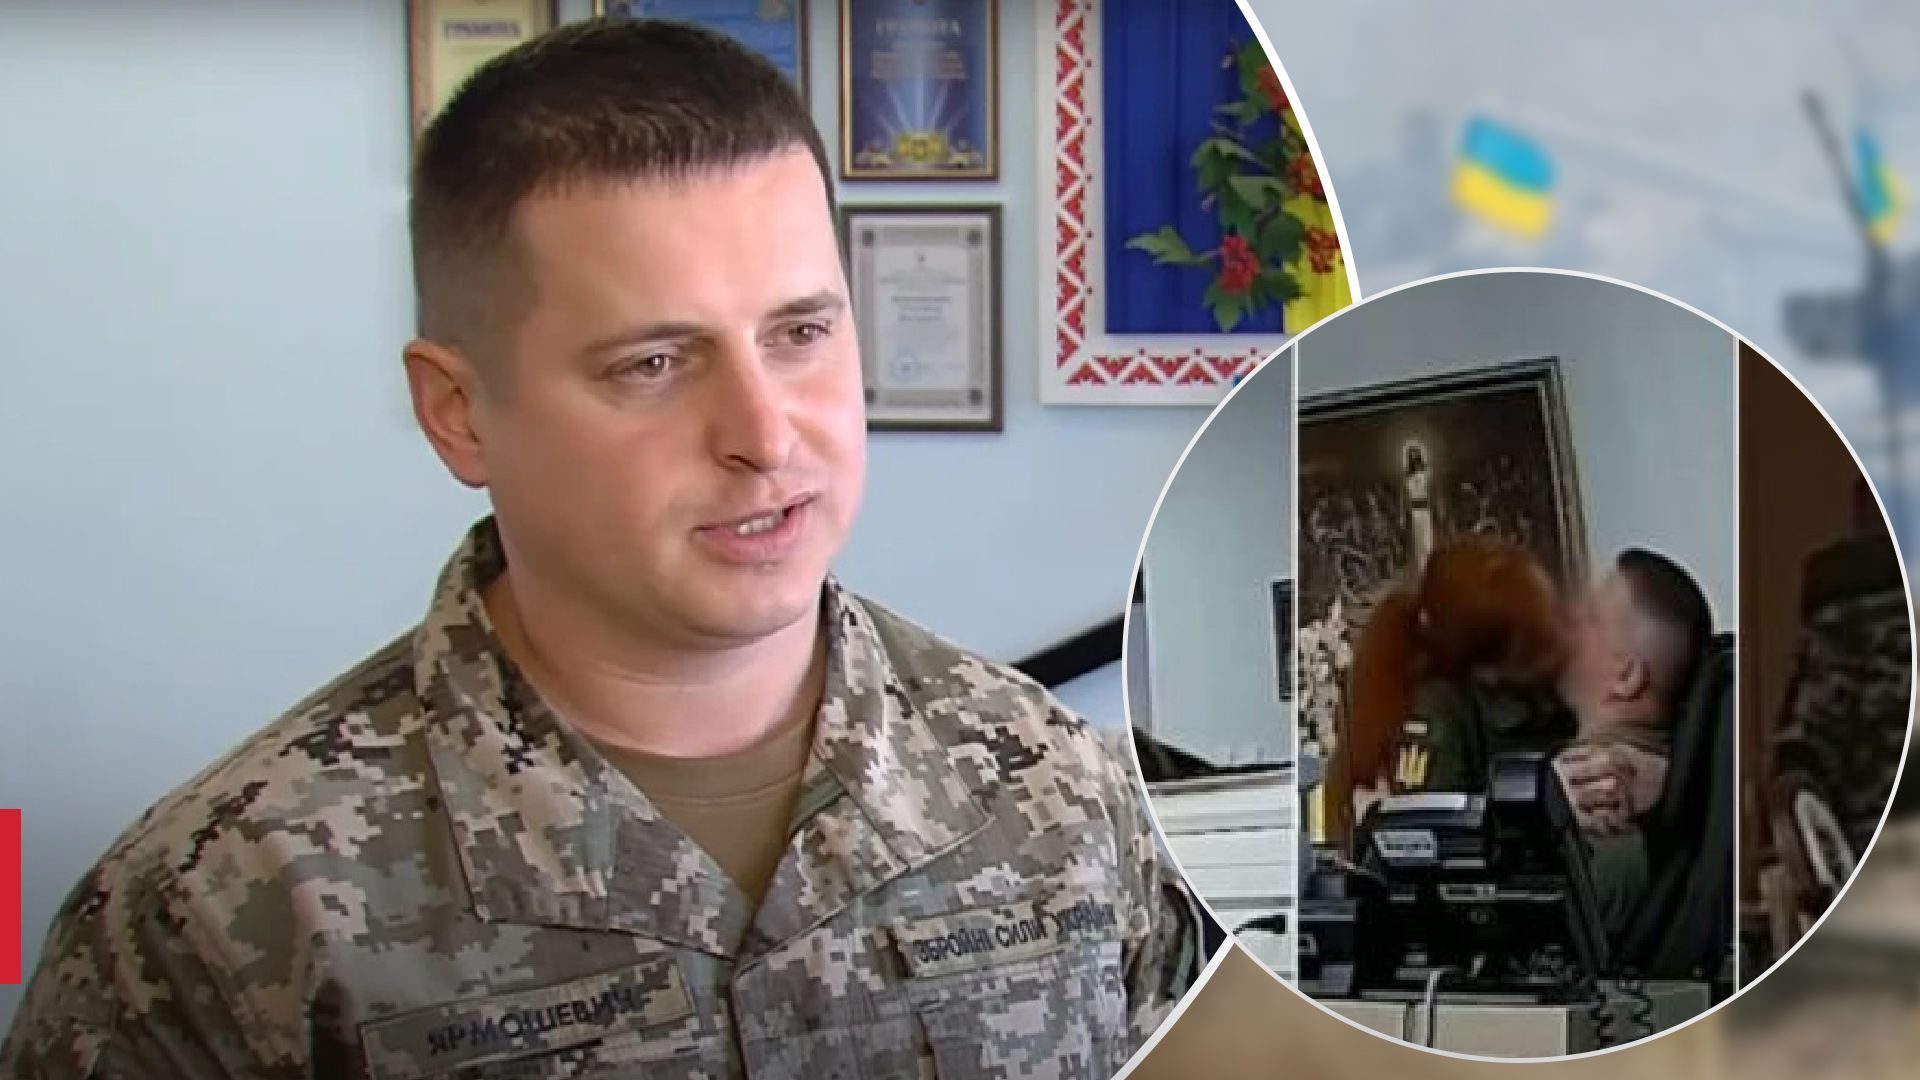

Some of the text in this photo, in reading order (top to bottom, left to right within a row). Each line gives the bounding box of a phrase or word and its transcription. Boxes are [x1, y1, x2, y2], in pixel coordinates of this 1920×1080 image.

[912, 927, 995, 963] ЗБРОЙНІ
[995, 917, 1048, 948] СИЛИ
[428, 983, 633, 1056] ЯРМОШЕВИЧ
